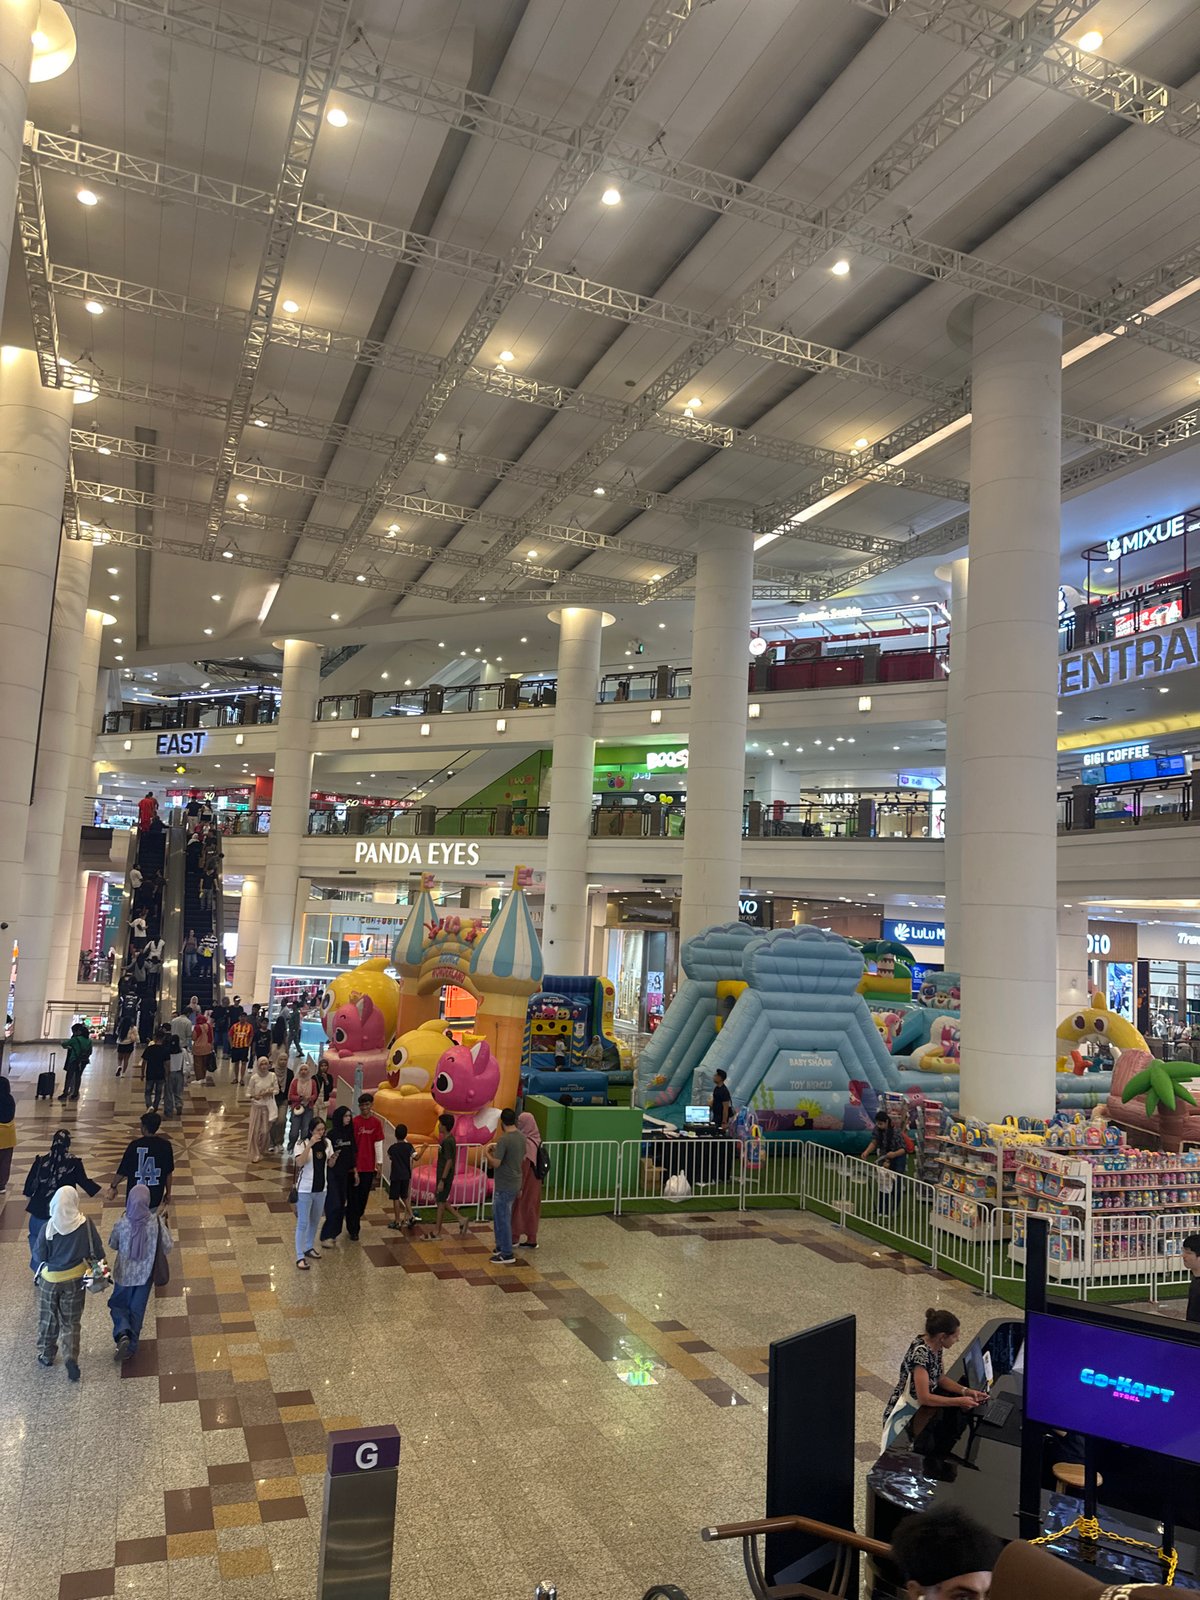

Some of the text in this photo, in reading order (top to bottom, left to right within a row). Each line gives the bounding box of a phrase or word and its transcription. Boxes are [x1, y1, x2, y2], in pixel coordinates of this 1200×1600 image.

[1122, 515, 1185, 555] MIXUE
[1059, 622, 1200, 695] ENTRA
[157, 732, 205, 755] EAST
[1084, 745, 1150, 766] GIGI COFFEE
[355, 842, 480, 866] PANDA EYES
[911, 927, 935, 940] LuLu
[789, 1058, 833, 1067] BABY SHARK
[790, 1080, 805, 1090] TOY
[135, 1147, 161, 1186] LA
[355, 1441, 379, 1470] G
